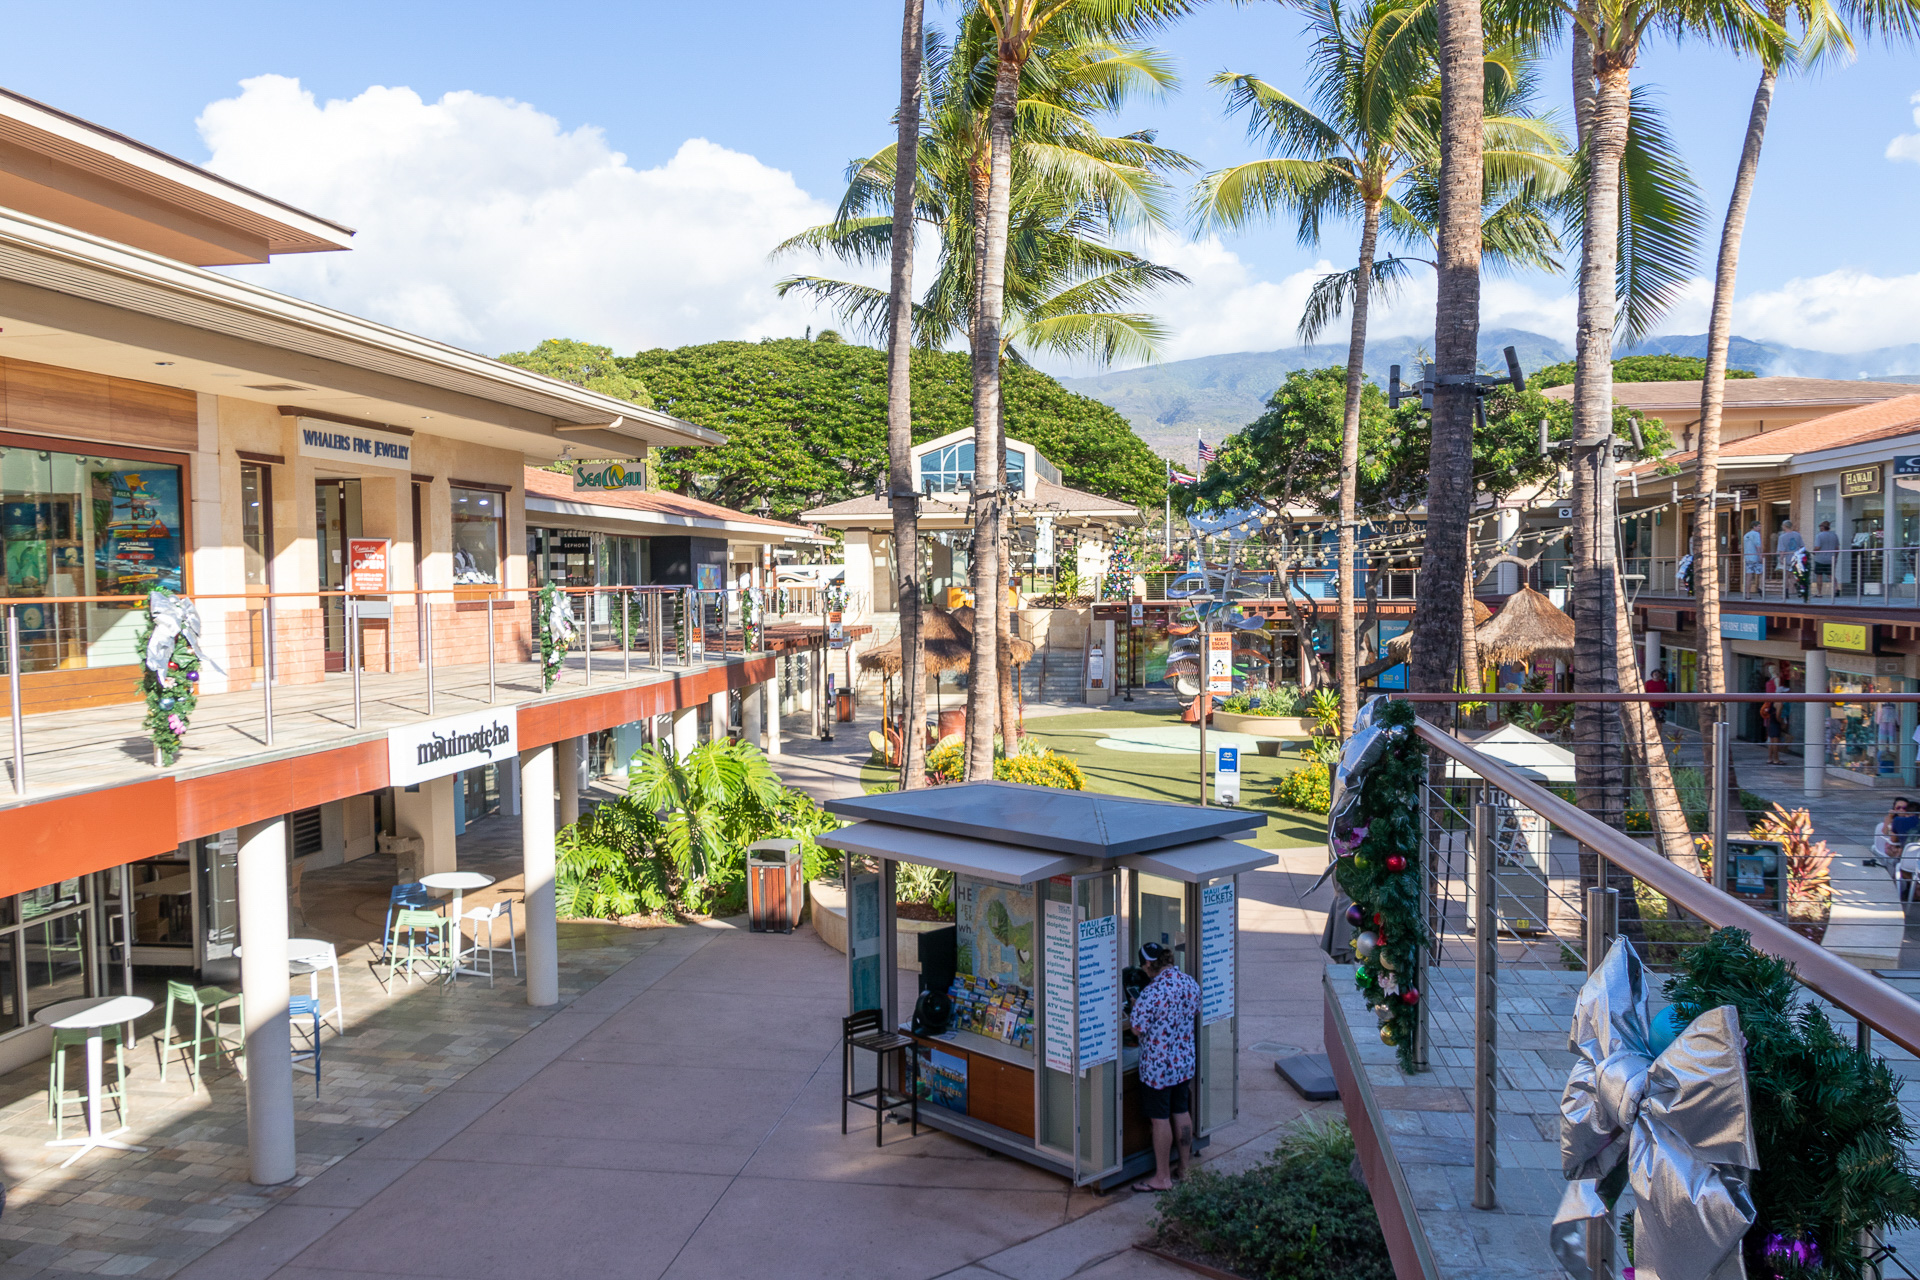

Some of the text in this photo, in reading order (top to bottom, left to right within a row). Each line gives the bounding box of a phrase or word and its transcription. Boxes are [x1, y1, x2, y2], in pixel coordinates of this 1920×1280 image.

[303, 429, 409, 460] WHALERS FINE JEWELRY
[577, 467, 601, 487] SEA
[1846, 471, 1873, 485] HAWAII
[353, 559, 385, 569] OPEN
[417, 720, 509, 765] mauimatcha
[1204, 887, 1219, 895] MAUI
[1204, 891, 1233, 903] TICKETS
[1046, 913, 1071, 923] helicopter
[1046, 921, 1068, 930] dolphin
[1080, 919, 1099, 929] MAUI
[1080, 923, 1115, 938] TICKETS
[1046, 961, 1065, 969] zipline
[1047, 982, 1069, 991] parasail
[1047, 1002, 1058, 1010] ATV
[1047, 1011, 1065, 1019] sunset
[1052, 1017, 1069, 1025] cruise
[1055, 1031, 1072, 1039] watch
[1047, 1037, 1068, 1046] atlantis
[1047, 1049, 1061, 1057] hana
